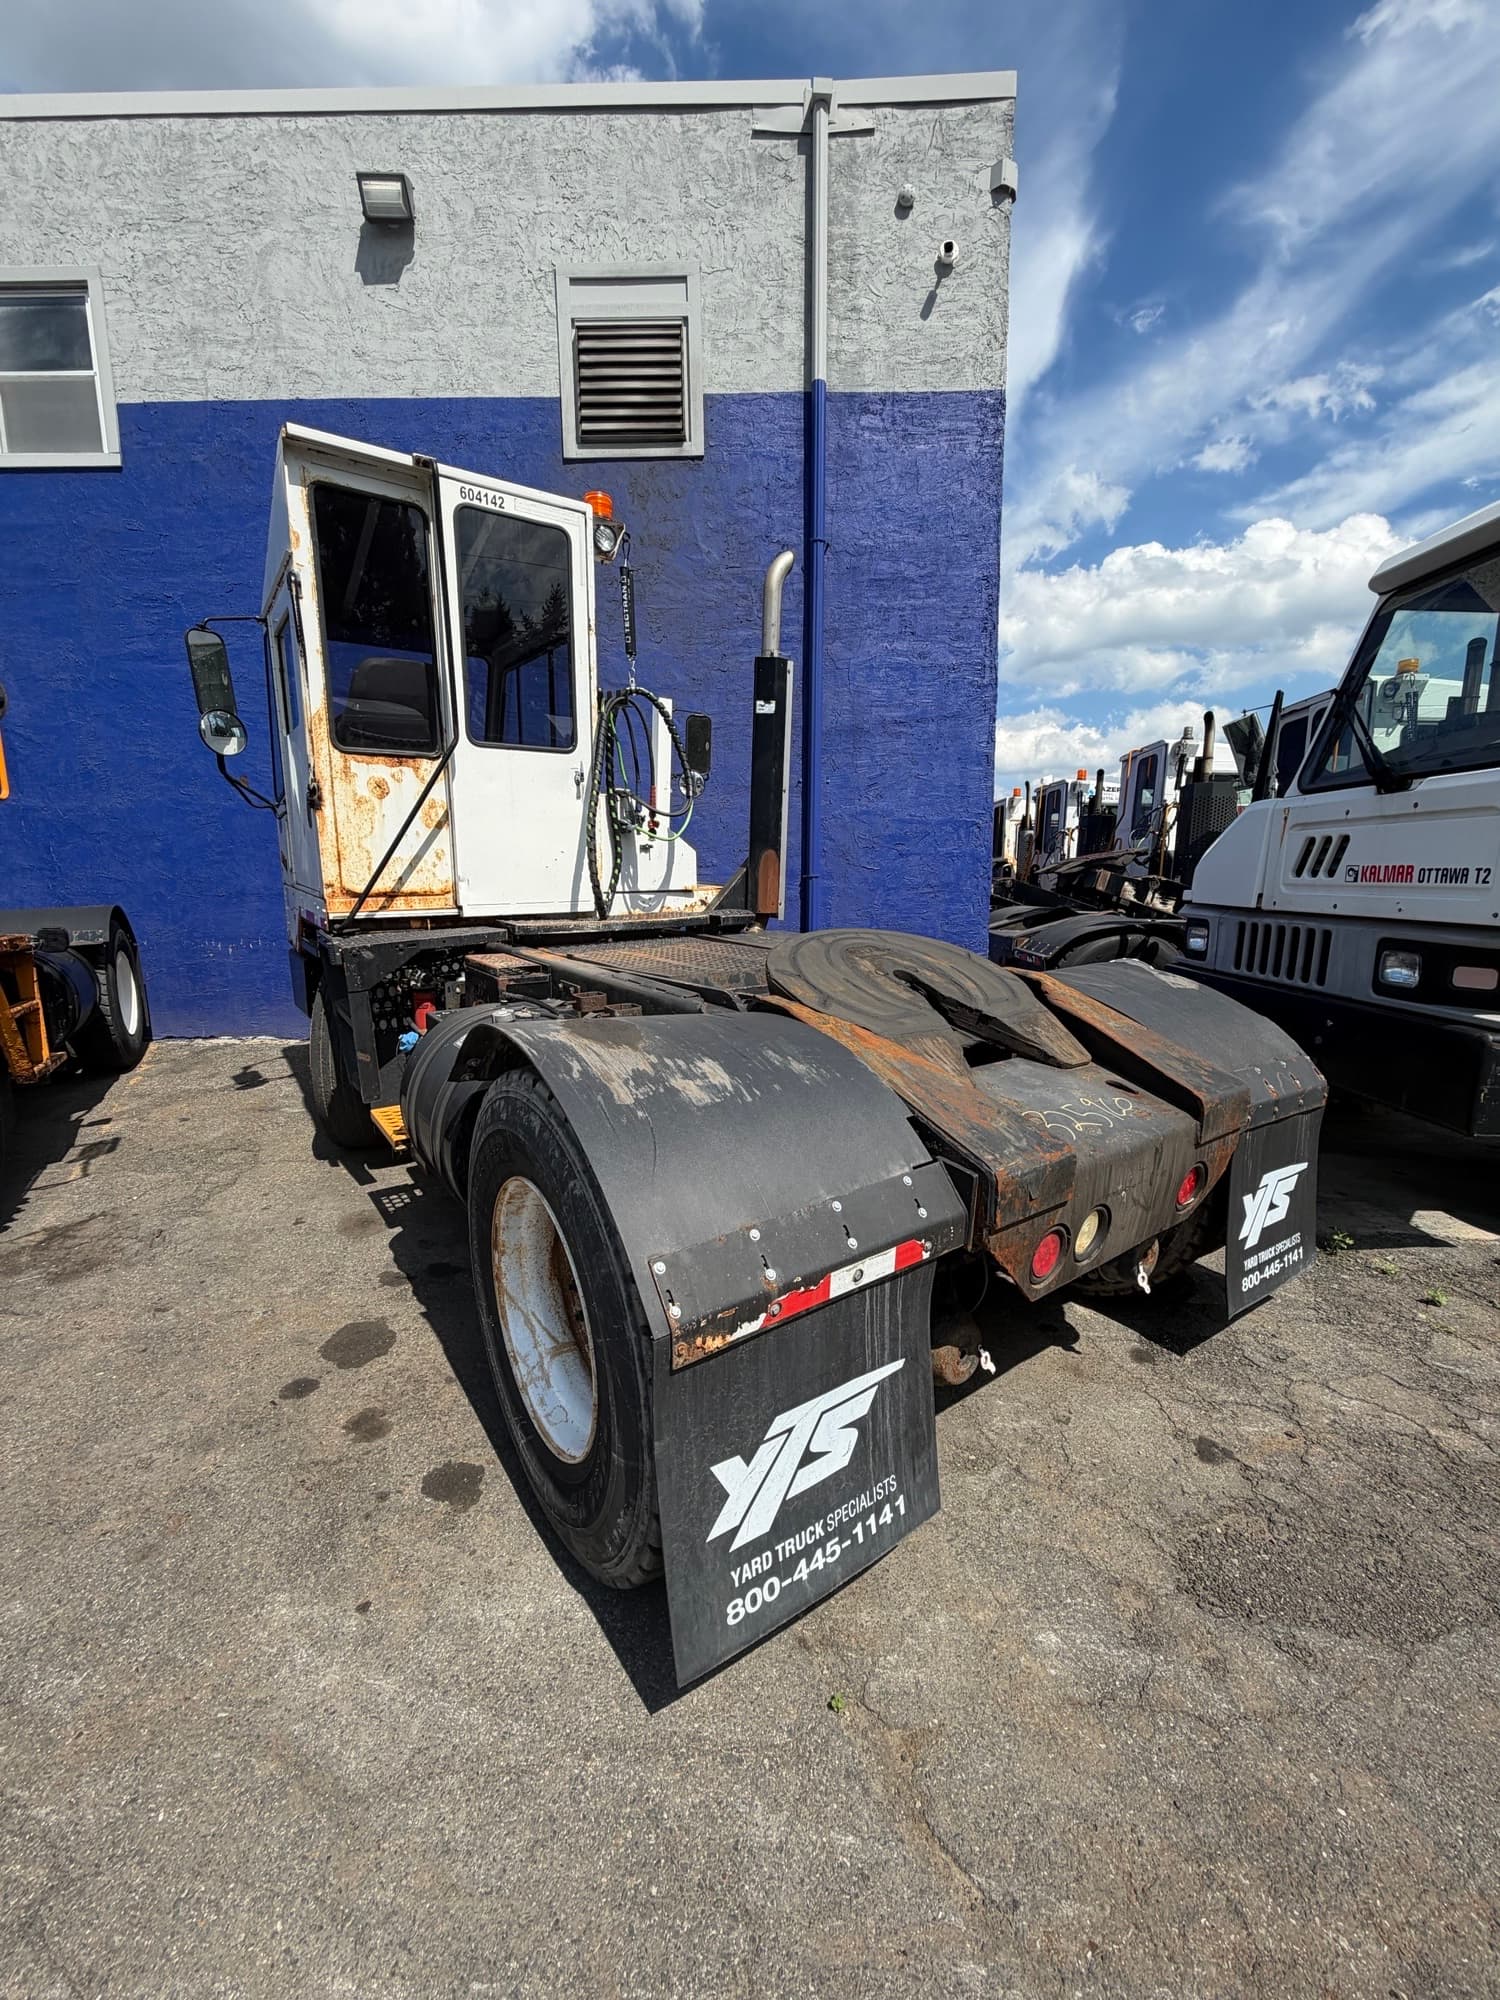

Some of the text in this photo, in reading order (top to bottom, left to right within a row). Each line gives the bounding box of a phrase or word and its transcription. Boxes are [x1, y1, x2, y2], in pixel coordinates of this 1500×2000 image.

[460, 485, 505, 509] 604142
[622, 585, 630, 632] TECTRAN
[1360, 865, 1492, 884] KALMAR OTTAWA T2
[1238, 1162, 1308, 1250] YTS
[1242, 1246, 1303, 1292] 800-445-1141
[1243, 1232, 1301, 1271] YARD TRUCK SPECIALISTS
[706, 1358, 905, 1552] YTS
[730, 1474, 897, 1588] YARD TRUCK SPECIALISTS
[727, 1494, 906, 1626] 800-445-1141
